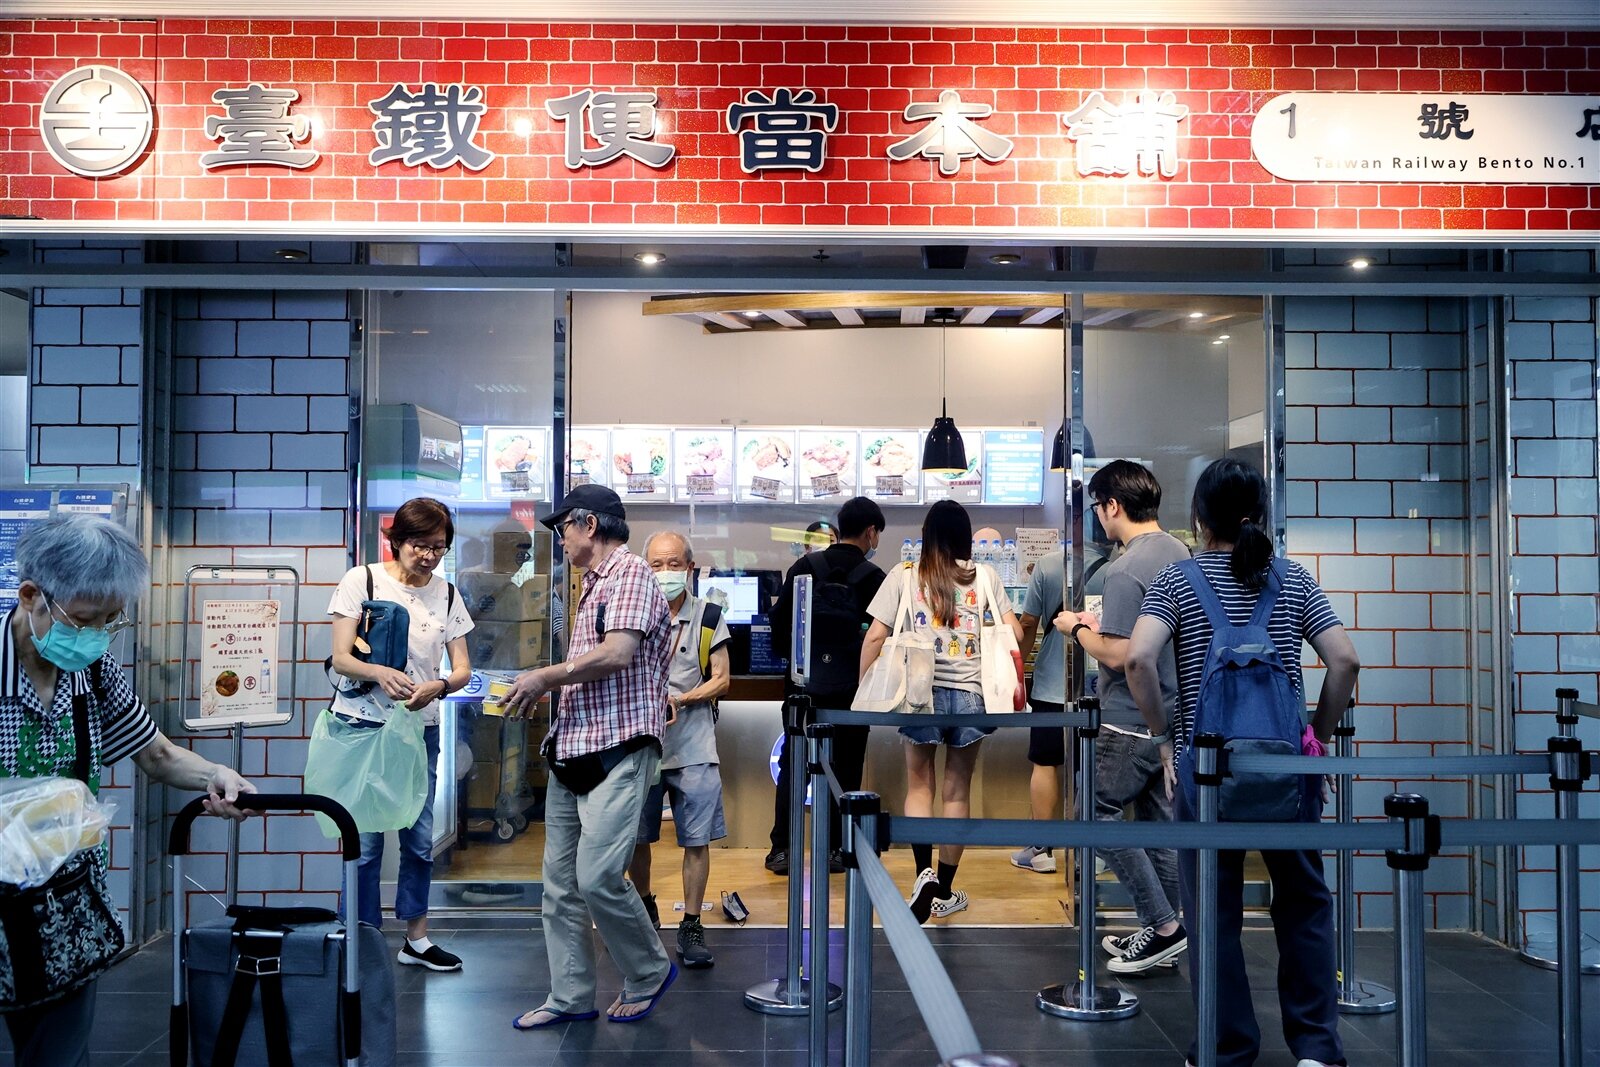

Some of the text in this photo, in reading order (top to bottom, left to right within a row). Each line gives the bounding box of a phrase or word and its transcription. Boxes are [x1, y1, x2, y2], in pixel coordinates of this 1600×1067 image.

[1313, 156, 1586, 172] Taiwan Railway Bento No.1
